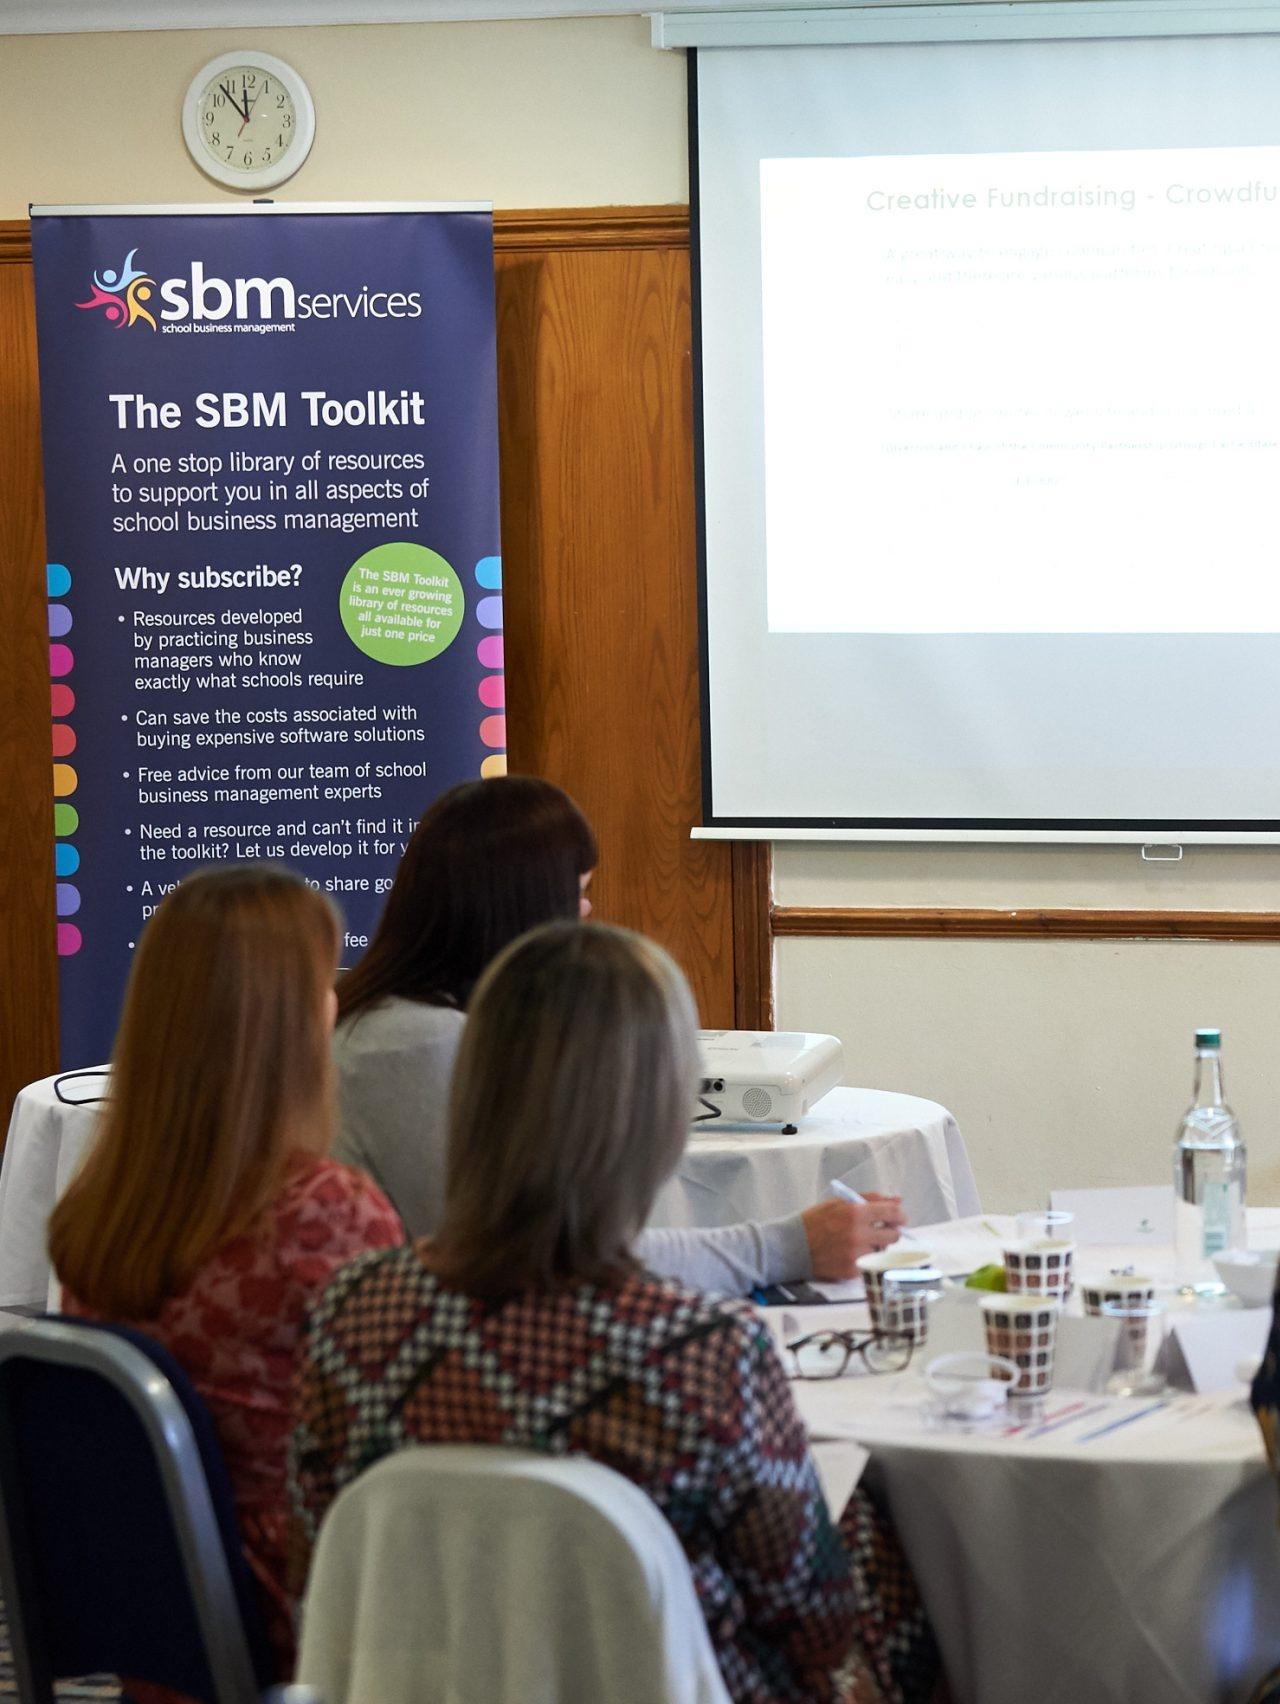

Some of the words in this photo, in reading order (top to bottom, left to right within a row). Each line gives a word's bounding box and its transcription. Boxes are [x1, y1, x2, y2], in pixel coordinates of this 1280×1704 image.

[226, 80, 235, 94] 11
[242, 74, 256, 88] 12
[213, 94, 225, 108] 10
[276, 95, 284, 108] 2
[206, 112, 214, 126] 9
[282, 114, 290, 128] 3
[212, 132, 220, 145] 8
[276, 134, 283, 147] 4
[226, 146, 234, 159] 7
[244, 152, 252, 166] 6
[262, 148, 270, 161] 5
[866, 187, 977, 211] Creative
[987, 186, 1136, 211] Fundraising
[161, 324, 192, 334] school
[193, 323, 232, 333] business
[233, 323, 295, 335] management
[109, 393, 182, 429] The
[195, 392, 287, 428] SBM
[301, 390, 425, 427] Toolkit
[111, 453, 127, 474] A
[133, 456, 172, 474] one
[178, 454, 222, 476] stop
[229, 452, 294, 474] library
[301, 450, 321, 471] of
[328, 453, 425, 470] resources
[111, 484, 132, 503] to
[138, 484, 218, 506] support
[225, 485, 261, 505] you
[269, 481, 288, 500] in
[295, 481, 318, 499] all
[325, 481, 403, 502] aspects
[410, 478, 429, 498] of
[112, 512, 179, 532] school
[187, 511, 276, 531] business
[284, 509, 419, 532] management
[115, 567, 171, 595] Why
[178, 564, 302, 590] subscribe?
[360, 568, 379, 580] The
[383, 571, 409, 583] SBM
[413, 573, 449, 588] Toolkit
[353, 581, 361, 592] is
[365, 585, 378, 594] an
[382, 587, 405, 597] ever
[408, 590, 452, 605] growing
[349, 595, 384, 611] library
[387, 600, 398, 610] of
[401, 603, 453, 616] resources
[133, 610, 215, 626] Resources
[221, 609, 302, 628] developed
[358, 611, 371, 621] all
[375, 614, 422, 627] available
[426, 618, 442, 629] for
[133, 632, 153, 649] by
[159, 631, 238, 650] practicing
[244, 630, 313, 645] business
[361, 625, 381, 637] just
[385, 630, 404, 639] one
[408, 631, 435, 642] price
[134, 654, 213, 671] managers
[218, 651, 253, 667] who
[258, 651, 301, 667] know
[134, 674, 190, 692] exactly
[197, 673, 236, 688] what
[242, 672, 302, 687] schools
[308, 671, 364, 688] require
[136, 710, 167, 726] Can
[173, 712, 209, 725] save
[215, 709, 240, 724] the
[246, 709, 287, 724] costs
[293, 706, 376, 723] associated
[382, 706, 417, 721] with
[136, 730, 191, 749] buying
[196, 729, 275, 748] expensive
[280, 727, 348, 744] software
[354, 726, 425, 742] solutions
[138, 767, 172, 783] Free
[177, 765, 229, 782] advice
[235, 764, 272, 781] from
[277, 766, 304, 780] our
[309, 763, 350, 779] team
[355, 763, 371, 778] of
[375, 762, 426, 778] school
[138, 787, 208, 803] business
[214, 786, 319, 805] management
[324, 785, 382, 802] experts
[140, 824, 182, 839] Need
[188, 826, 197, 838] a
[204, 823, 270, 838] resource
[277, 820, 306, 836] and
[312, 819, 352, 836] can't
[357, 818, 386, 834] find
[392, 818, 402, 833] it
[140, 846, 166, 860] the
[172, 844, 229, 860] toolkit?
[236, 842, 260, 858] Let
[267, 844, 284, 858] us
[290, 841, 352, 858] develop
[358, 840, 368, 856] it
[374, 840, 394, 855] for
[142, 881, 152, 896] A
[326, 876, 369, 891] share
[374, 878, 394, 894] go
[344, 932, 368, 948] fee
